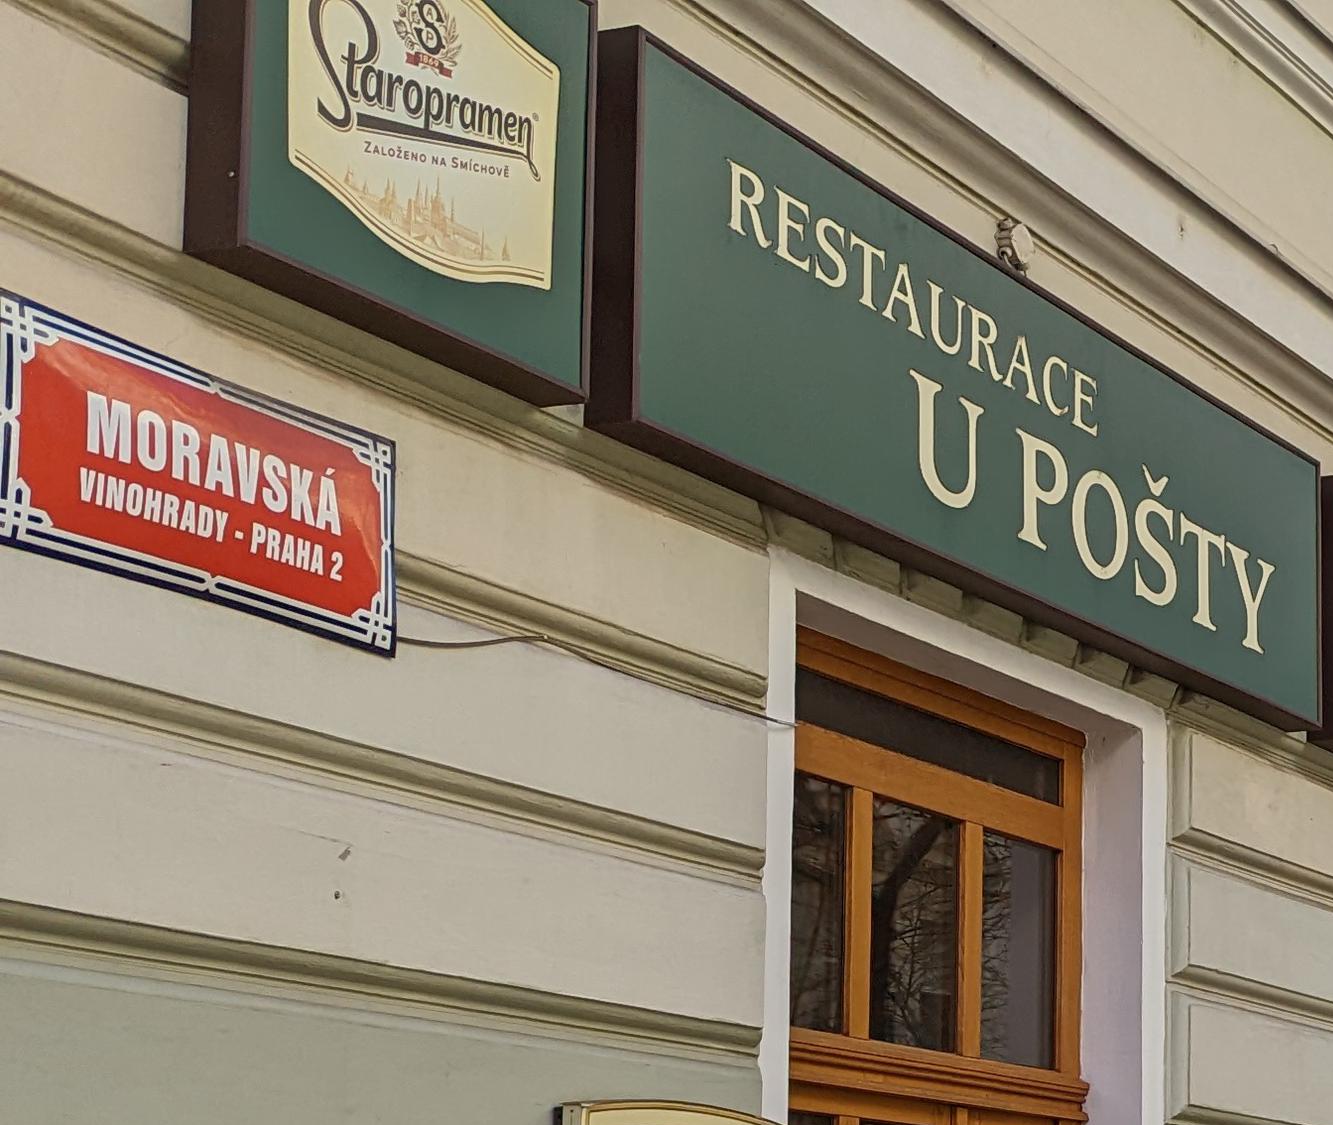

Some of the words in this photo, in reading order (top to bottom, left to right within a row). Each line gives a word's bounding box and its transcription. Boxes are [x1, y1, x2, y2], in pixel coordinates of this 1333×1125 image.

[308, 0, 541, 181] Staropramen
[419, 53, 440, 68] 1869
[364, 141, 427, 163] ZALOŽENO
[431, 155, 447, 167] NA
[451, 156, 510, 178] SMÍCHOVĚ
[726, 158, 1099, 438] RESTAURACE
[79, 466, 227, 541] VINOHRADY
[250, 521, 325, 578] PRAHA
[330, 551, 344, 582] 2
[86, 390, 342, 536] MORAVSKÁ
[910, 369, 985, 509] U
[1016, 427, 1276, 655] POŠTY
